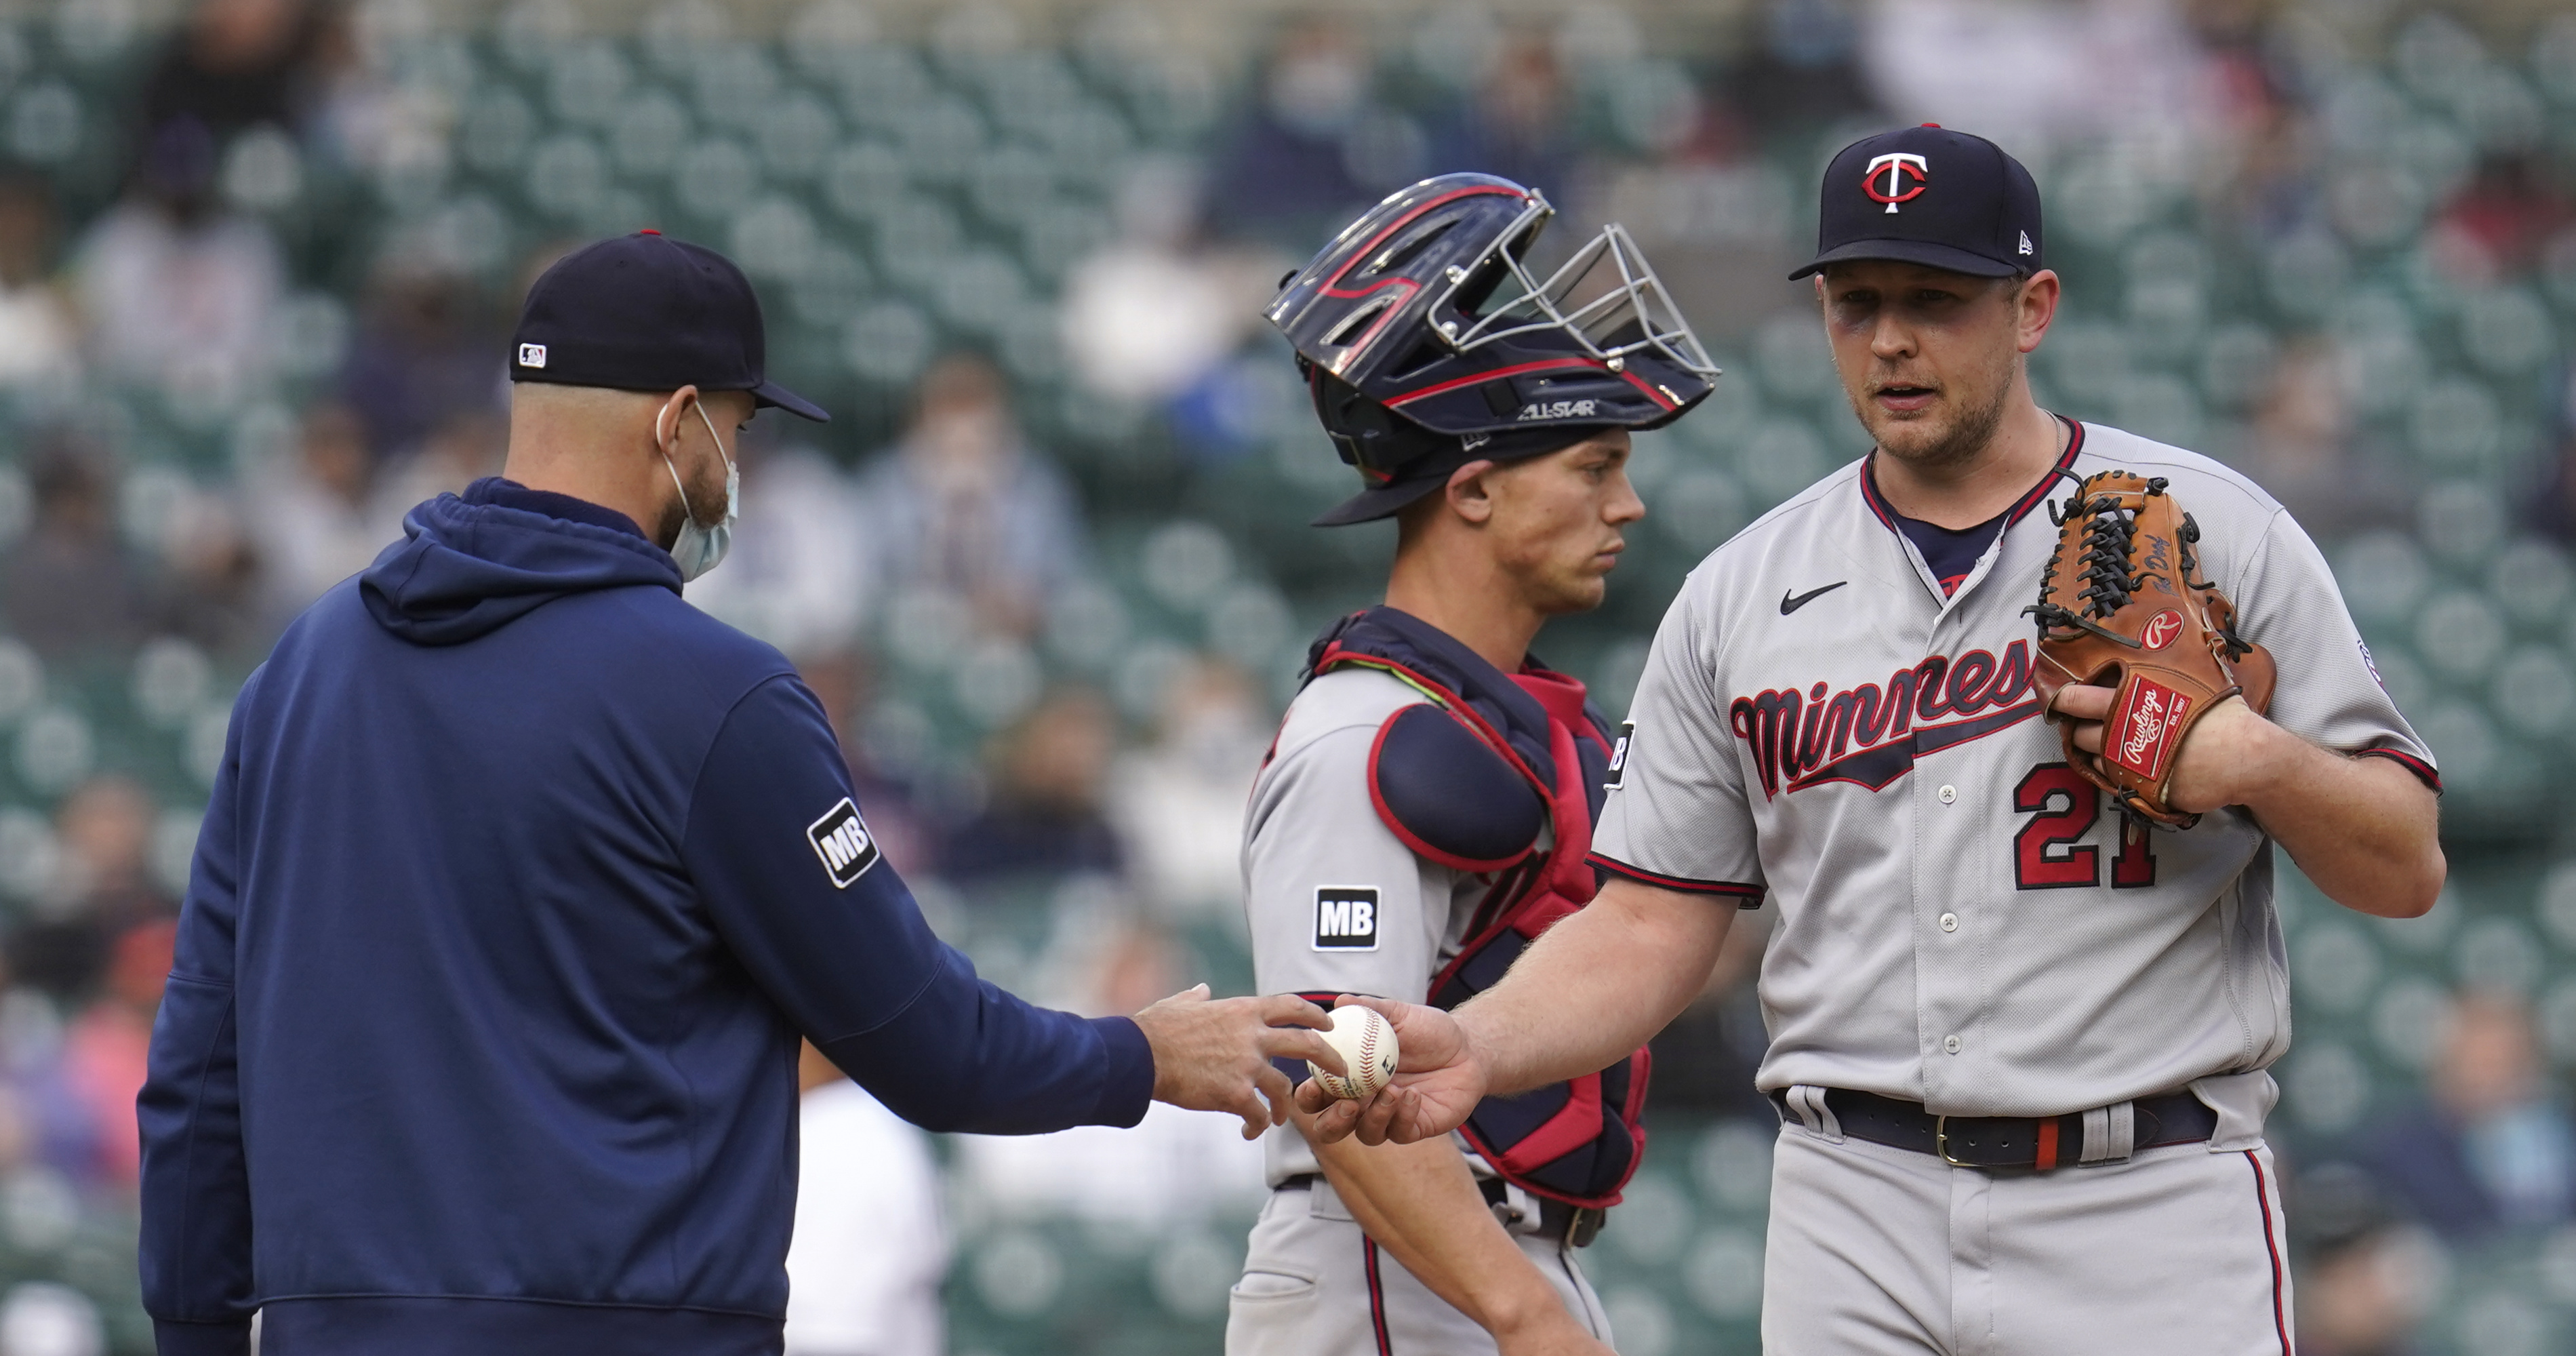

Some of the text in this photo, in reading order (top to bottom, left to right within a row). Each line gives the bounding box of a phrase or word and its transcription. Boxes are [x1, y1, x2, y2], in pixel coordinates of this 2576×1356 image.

[1730, 639, 2040, 803] Minnes
[2124, 689, 2163, 764] Rawlings
[820, 816, 869, 872] MB
[2013, 761, 2156, 890] 21
[1319, 900, 1374, 936] MB
